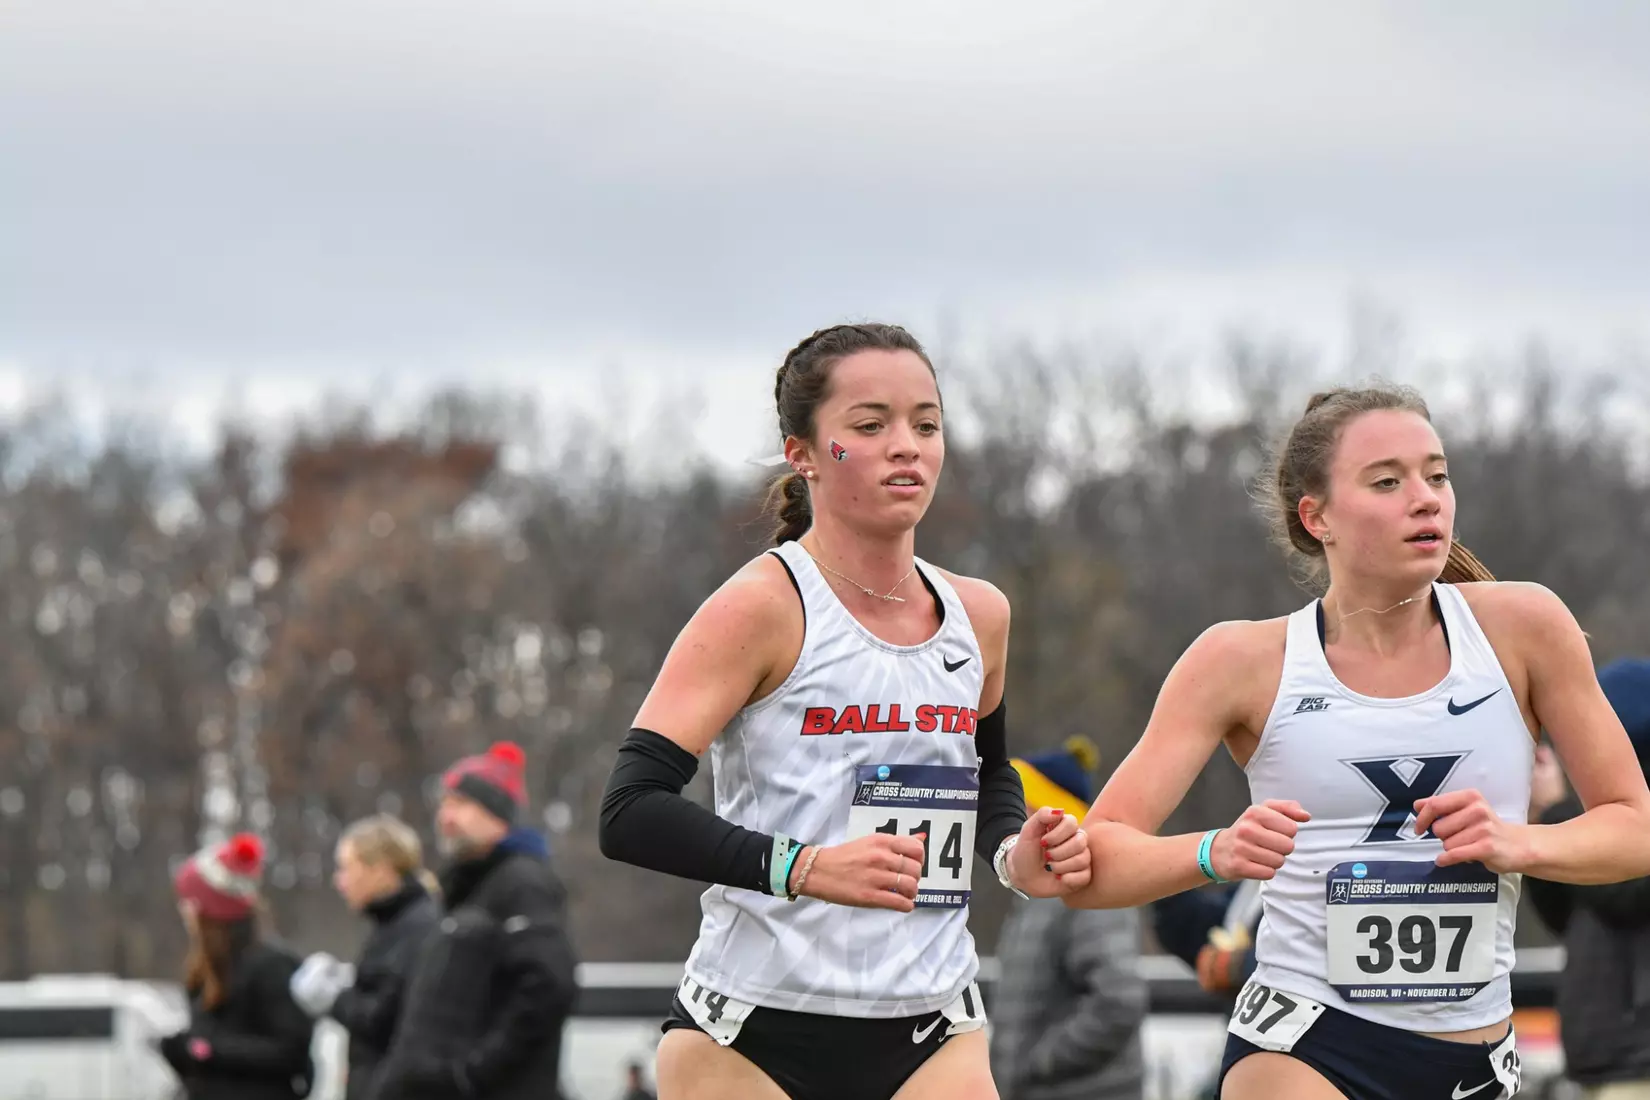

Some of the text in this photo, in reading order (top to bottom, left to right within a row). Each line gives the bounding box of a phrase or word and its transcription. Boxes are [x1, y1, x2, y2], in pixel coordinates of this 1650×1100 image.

[1296, 703, 1331, 711] EAST
[1300, 697, 1325, 705] BIG
[800, 703, 911, 736] BALL
[873, 786, 899, 798] CROSS
[900, 787, 935, 799] COUNTRY
[935, 789, 979, 801] CHAMPIONSHIPS
[875, 818, 962, 879] 14
[1351, 882, 1497, 894] CROSS COUNTRY CHAMPIONSHIPS
[913, 894, 945, 904] OVEMBER
[1356, 915, 1473, 974] 397
[1350, 987, 1477, 998] MADISON, WI NOVEMBER 10, 2023
